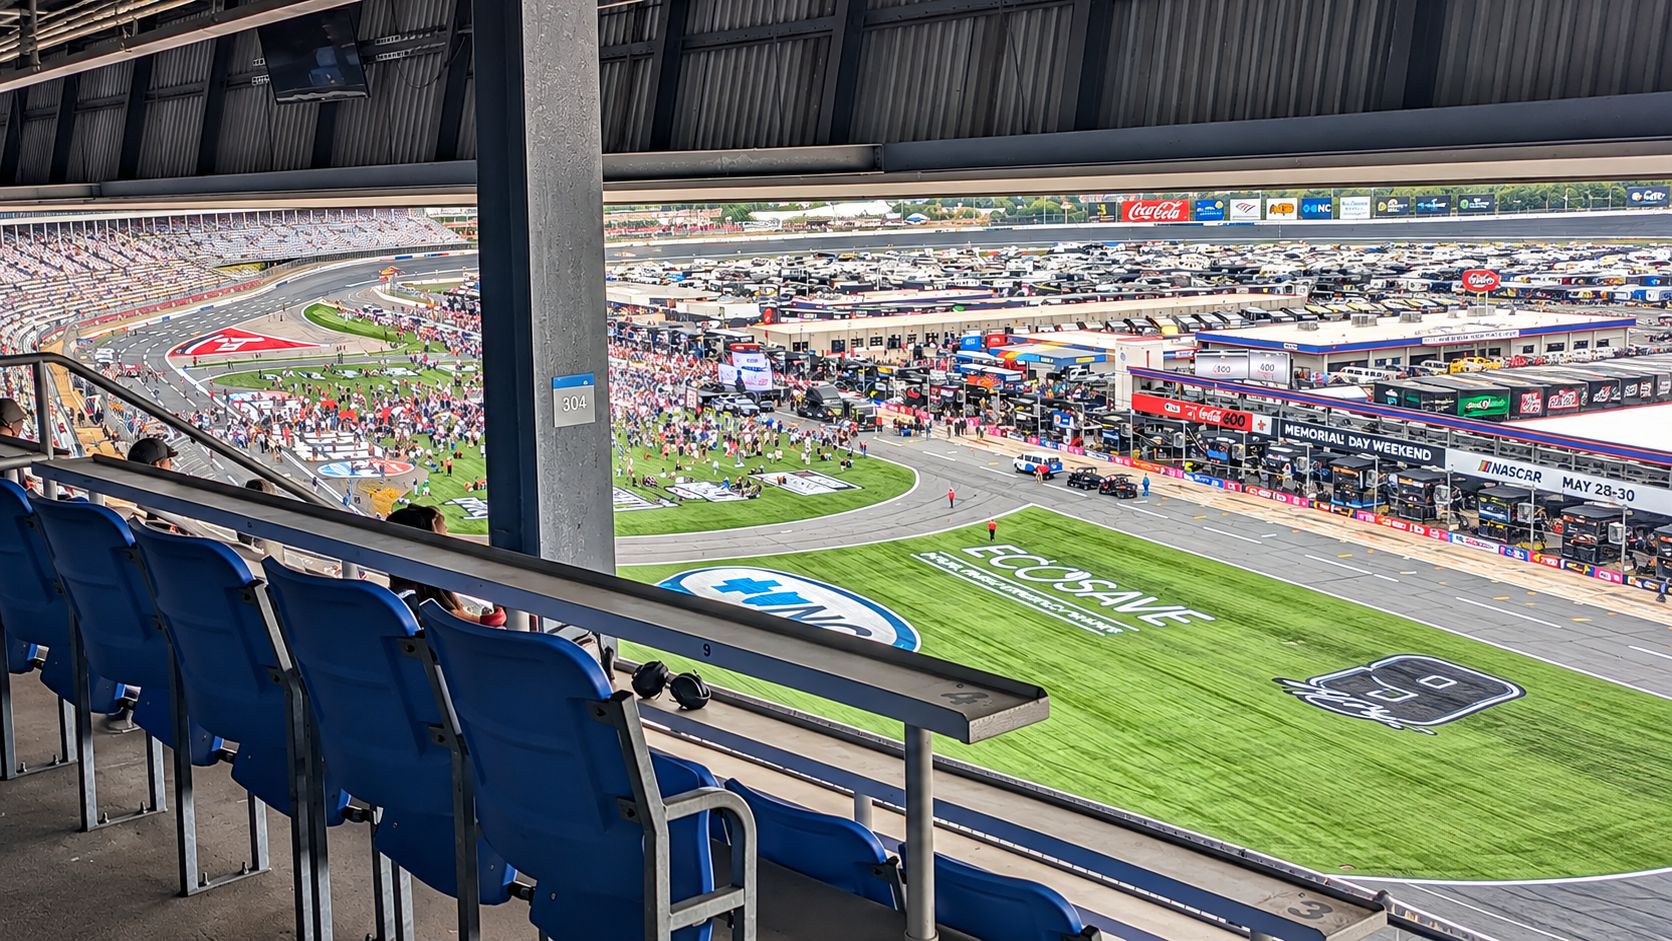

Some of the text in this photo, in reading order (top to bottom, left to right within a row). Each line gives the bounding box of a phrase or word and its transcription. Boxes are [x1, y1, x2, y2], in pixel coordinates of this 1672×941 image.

[563, 395, 587, 412] 304
[1223, 412, 1246, 427] 600
[1285, 424, 1432, 461] MEMORIAL DAY WEEKEND
[1491, 462, 1635, 501] NASCAR MAY 28-30
[703, 643, 711, 657] 9
[1287, 900, 1334, 920] 3
